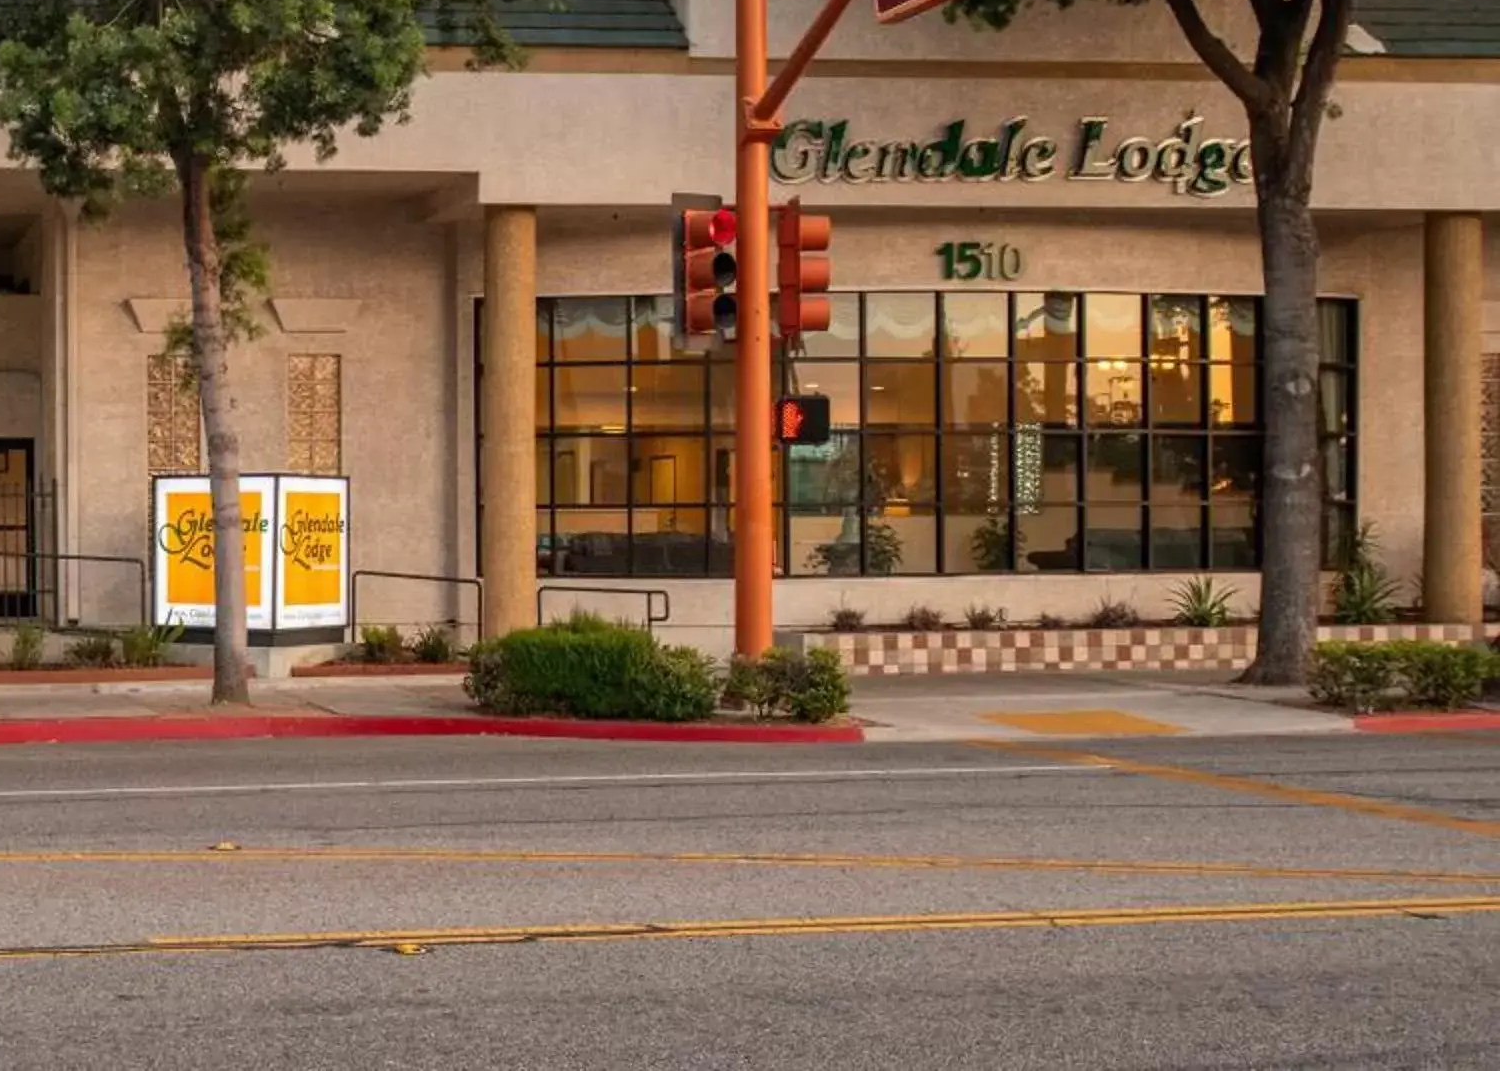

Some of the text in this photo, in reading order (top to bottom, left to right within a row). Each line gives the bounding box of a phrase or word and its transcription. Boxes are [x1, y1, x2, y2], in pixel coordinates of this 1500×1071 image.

[771, 116, 1057, 184] Glendale
[935, 241, 1021, 281] 1510
[292, 534, 332, 570] Lodge
